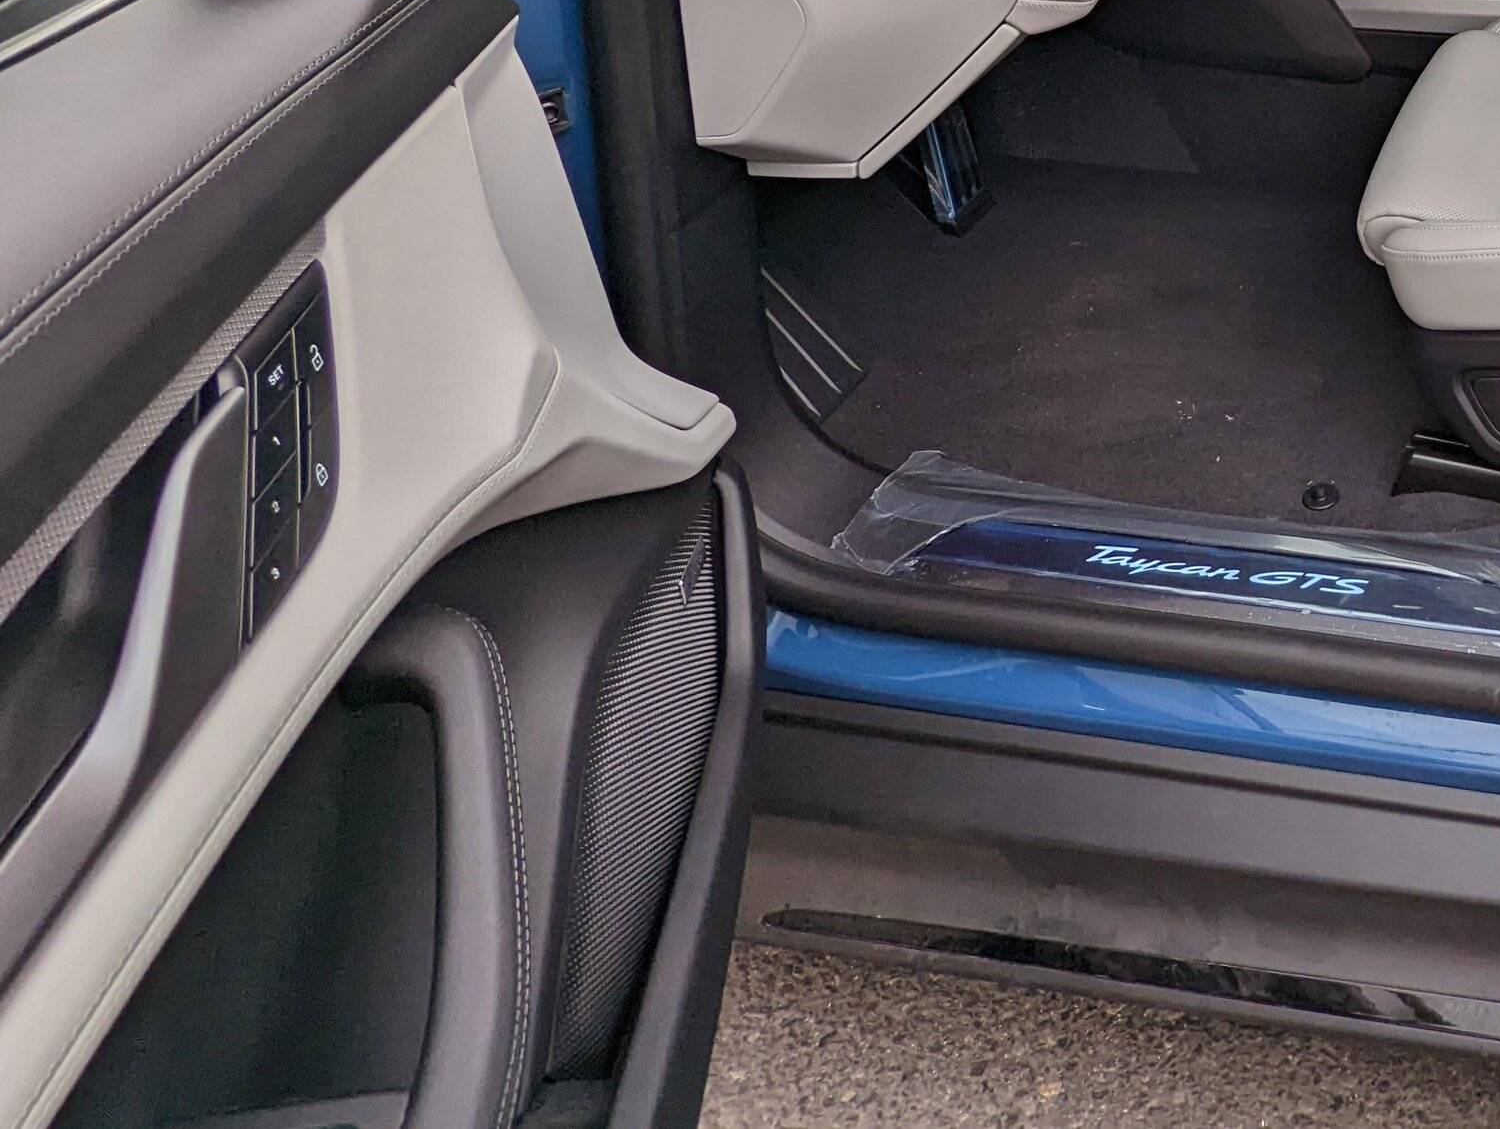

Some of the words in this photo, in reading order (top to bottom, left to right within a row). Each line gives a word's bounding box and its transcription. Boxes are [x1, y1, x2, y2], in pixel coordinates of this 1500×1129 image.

[268, 364, 285, 387] SET
[272, 436, 281, 446] 1
[271, 500, 280, 513] 2
[270, 567, 280, 580] 3
[1085, 545, 1240, 581] Taycan
[1249, 571, 1369, 595] GTS
